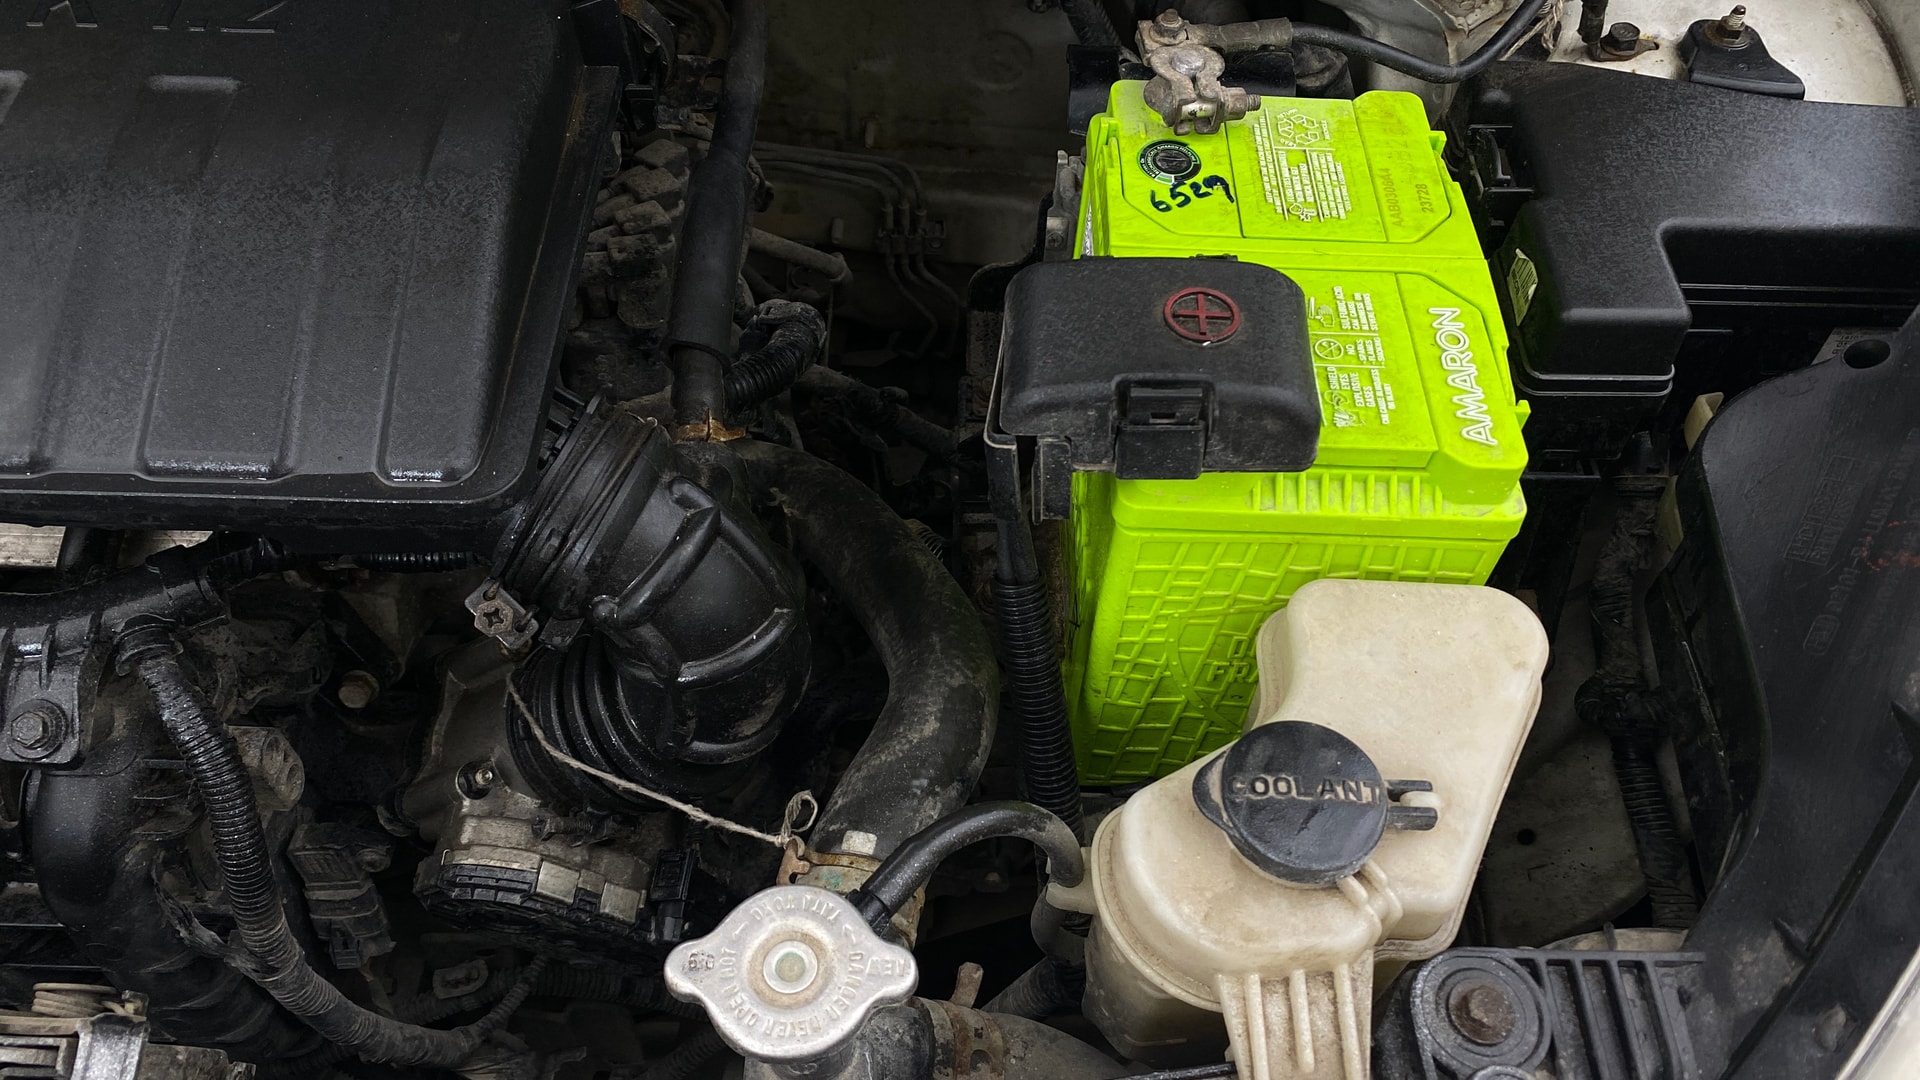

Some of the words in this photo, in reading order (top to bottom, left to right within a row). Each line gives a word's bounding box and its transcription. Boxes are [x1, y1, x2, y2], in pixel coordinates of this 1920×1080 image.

[1416, 183, 1434, 213] 23728
[1346, 344, 1356, 355] NO
[1327, 366, 1340, 390] SHIELD
[1340, 374, 1350, 390] EYES
[1350, 372, 1364, 407] EXPLOSIVE
[1428, 308, 1498, 446] AMARON
[1363, 386, 1376, 407] GASES
[1228, 776, 1380, 804] COOLANT
[722, 984, 760, 1026] OPEN
